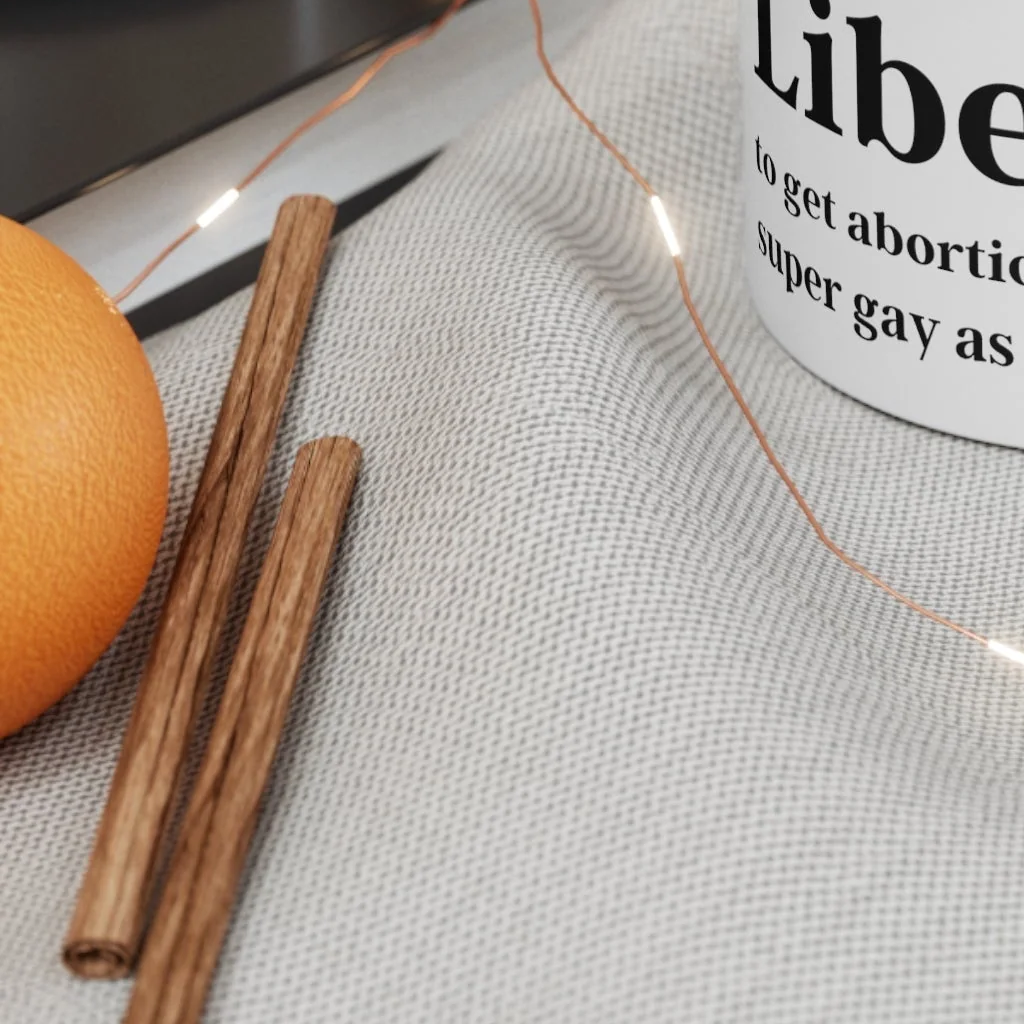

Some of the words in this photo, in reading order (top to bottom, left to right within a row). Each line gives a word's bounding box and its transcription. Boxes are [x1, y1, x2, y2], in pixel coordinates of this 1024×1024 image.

[754, 136, 777, 186] to
[783, 173, 837, 230] get
[757, 220, 843, 312] super
[853, 293, 941, 361] gay
[956, 327, 1015, 367] as
